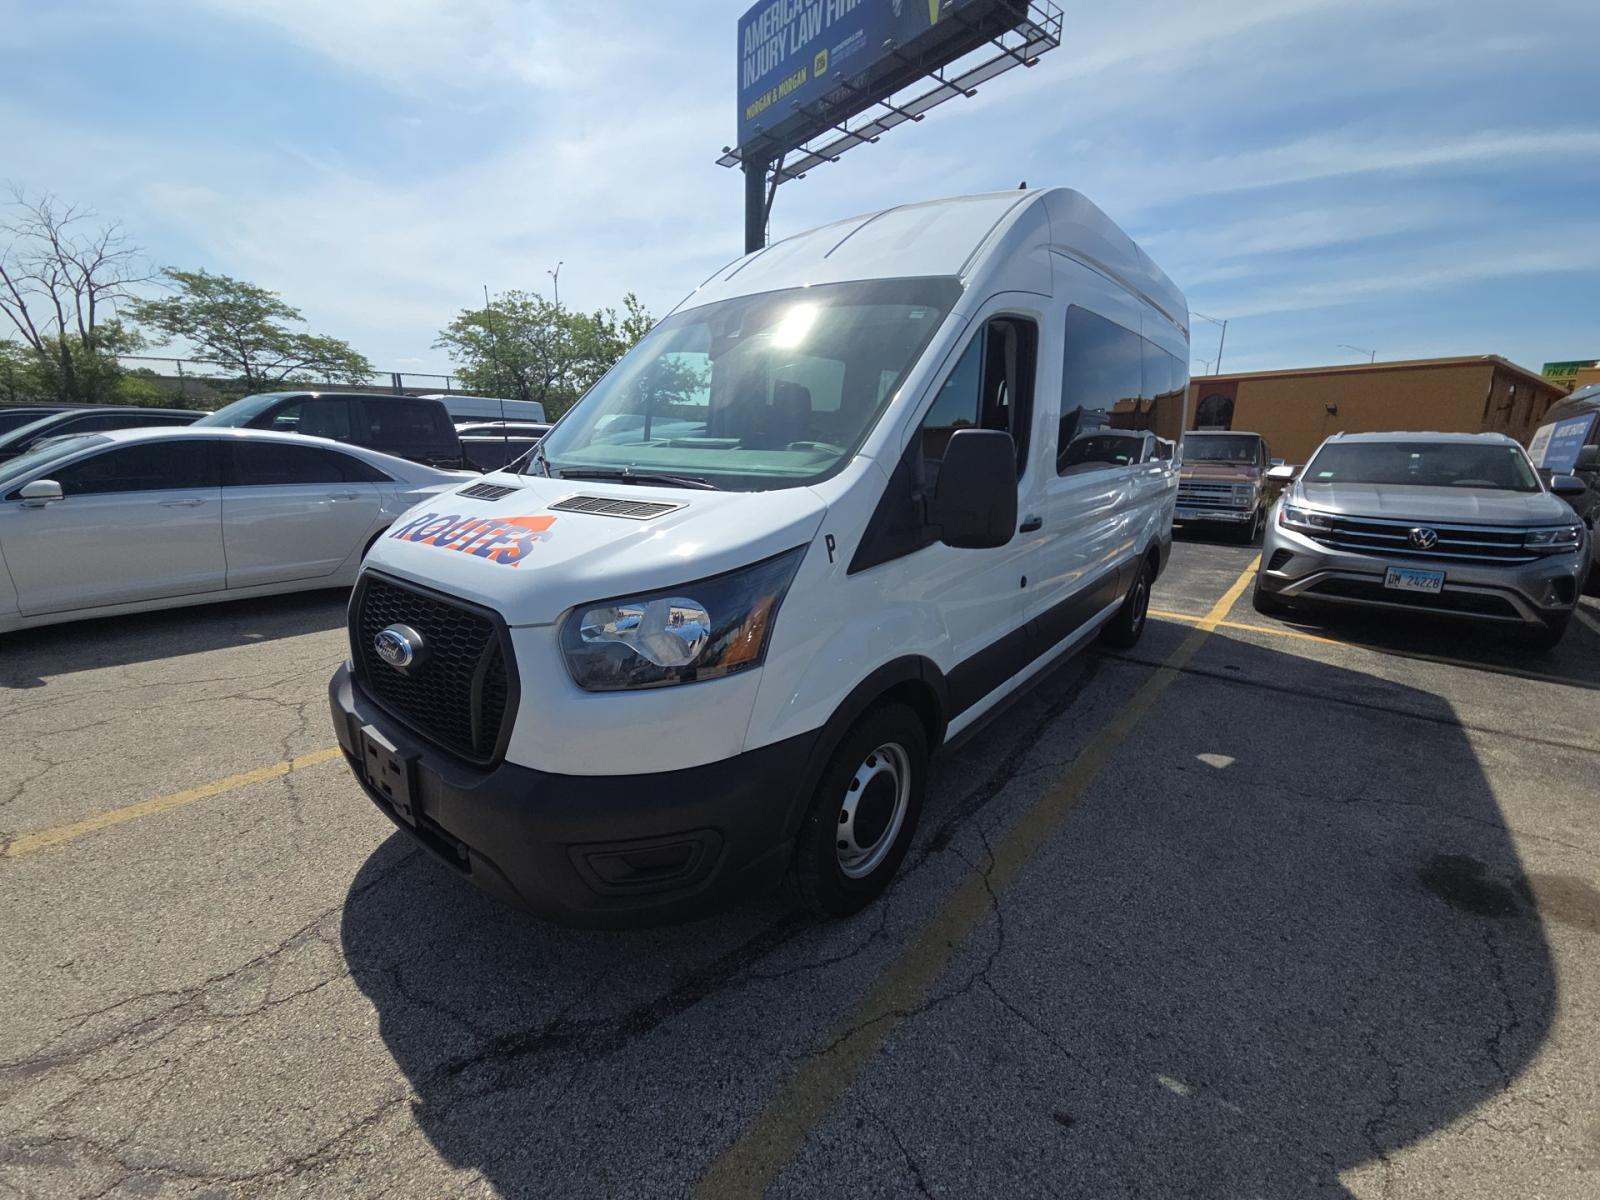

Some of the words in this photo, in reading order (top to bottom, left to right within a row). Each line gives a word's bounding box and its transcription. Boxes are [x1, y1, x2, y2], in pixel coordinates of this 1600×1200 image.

[742, 27, 788, 91] INJURY
[789, 0, 824, 55] LAW
[745, 89, 772, 121] MORGAN
[778, 66, 807, 100] MORGAN
[389, 513, 553, 565] ROUTES
